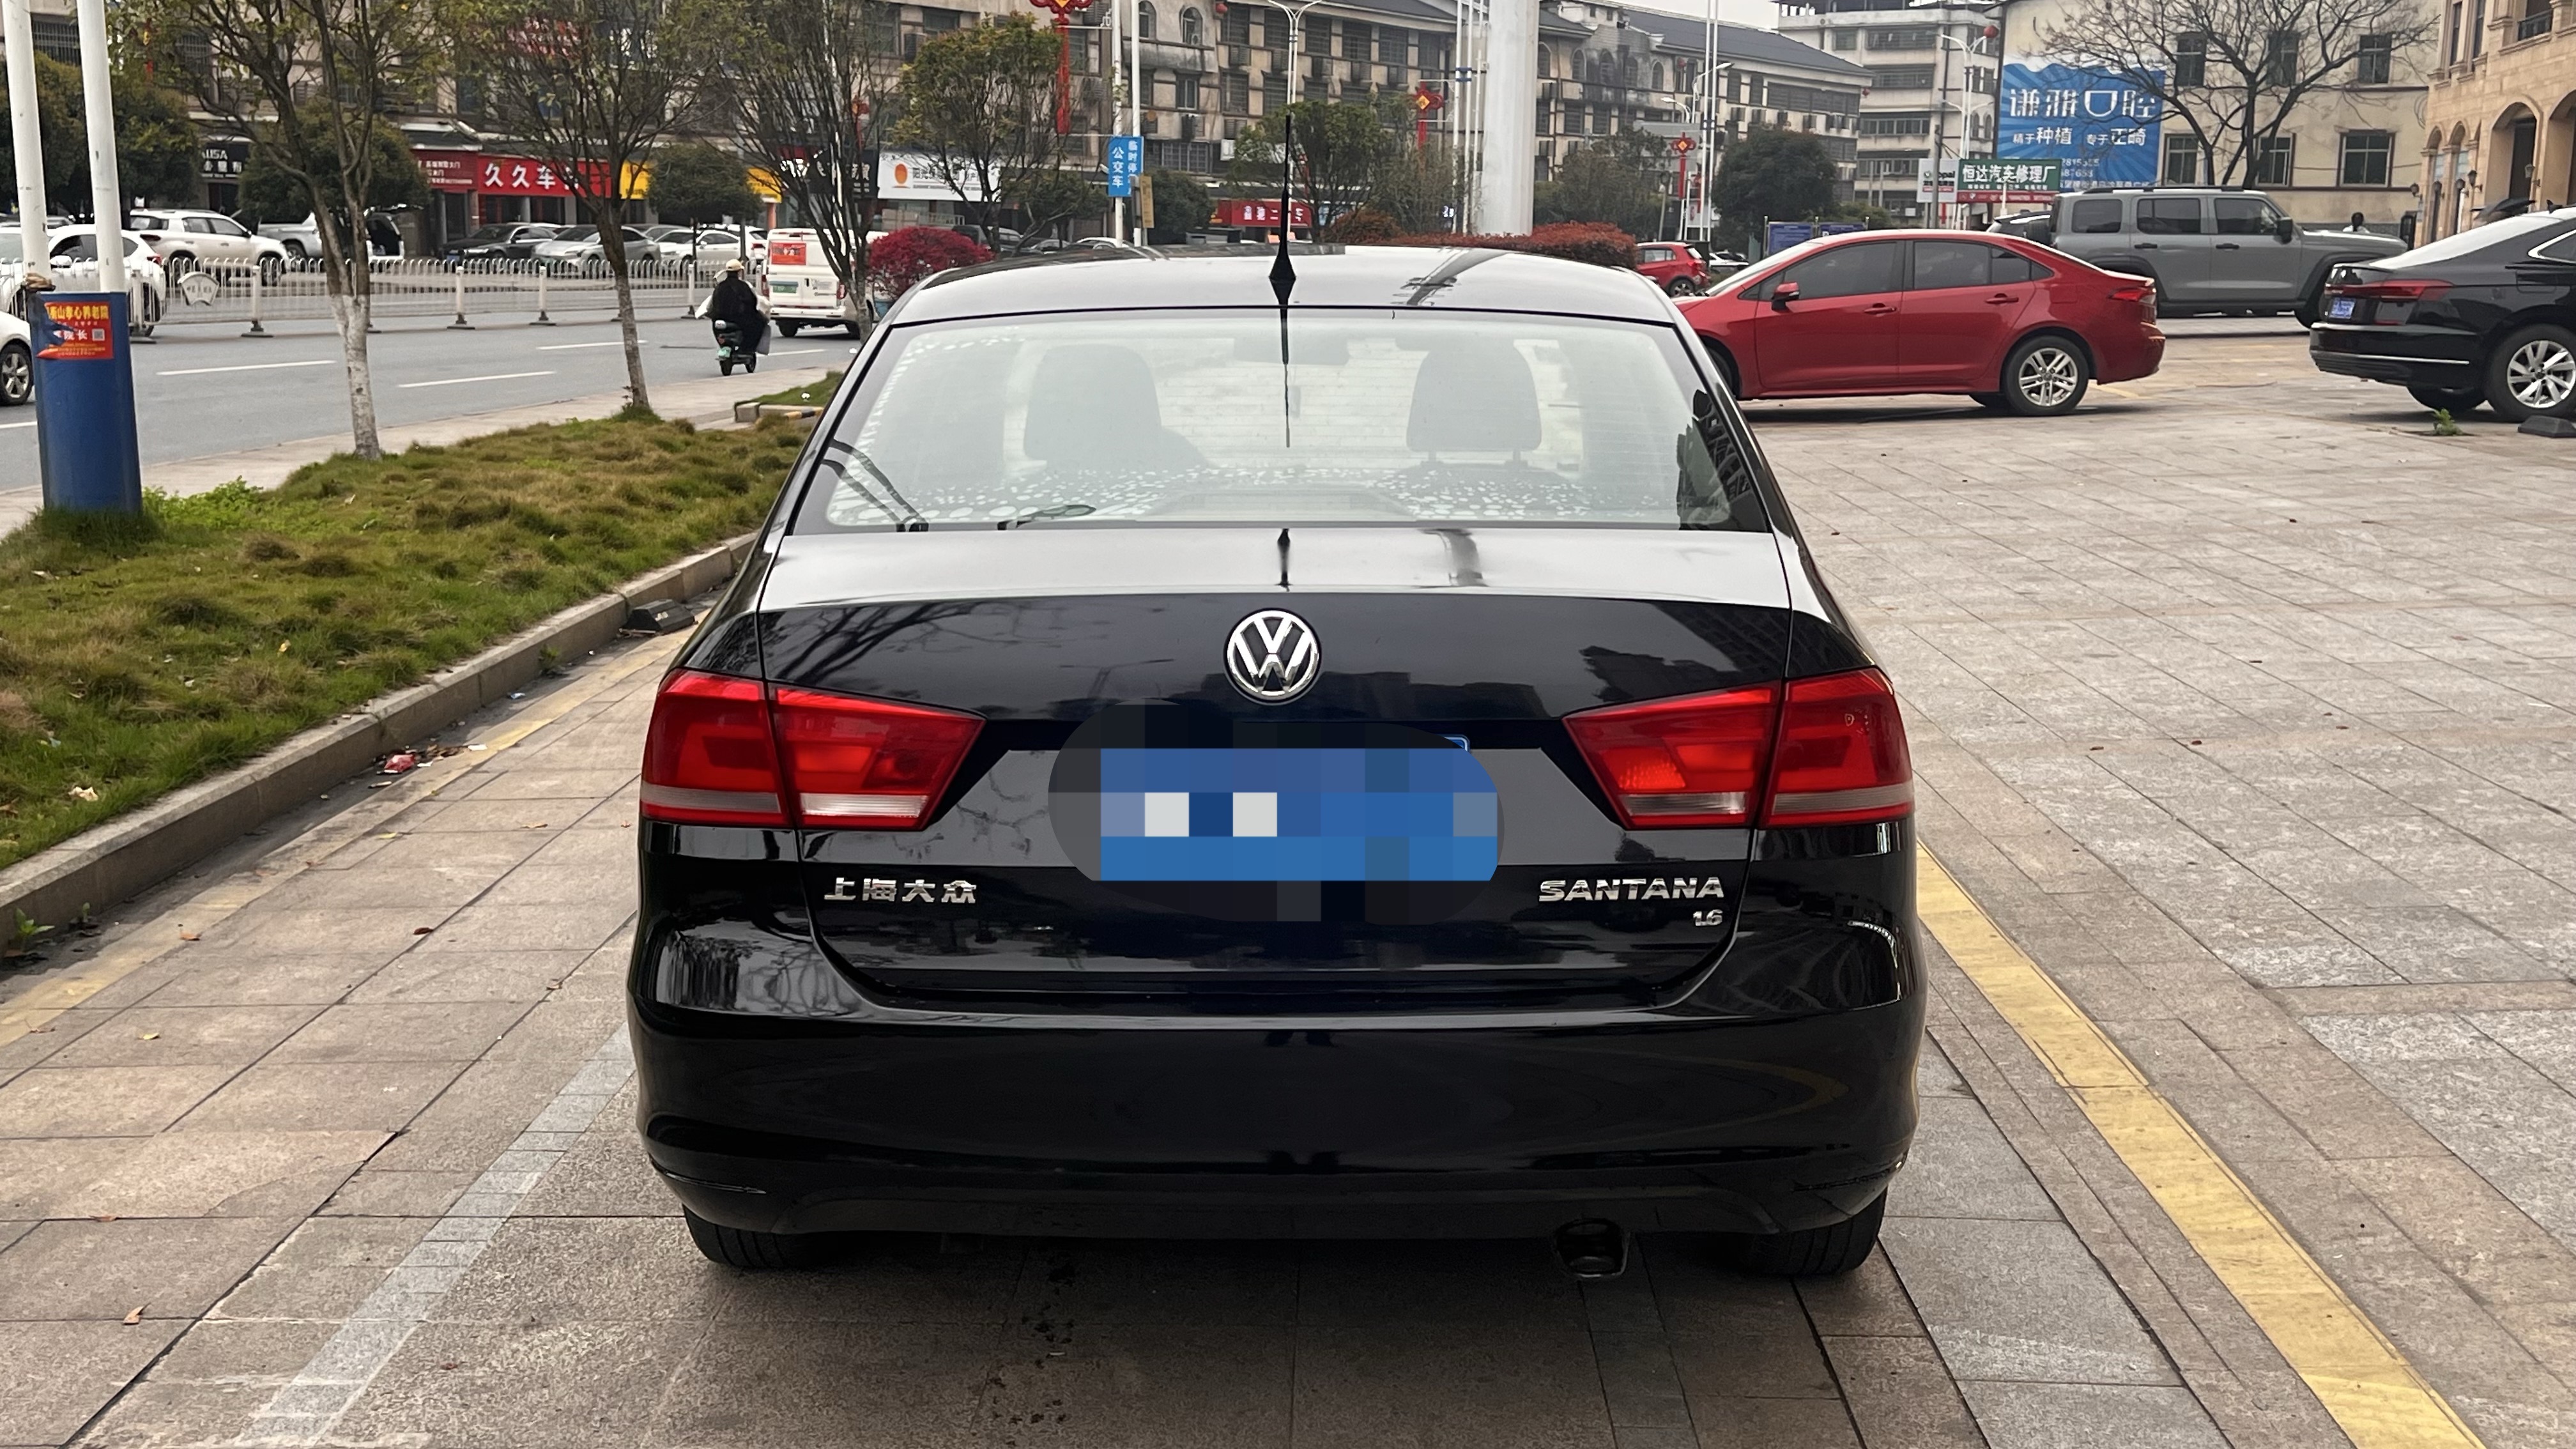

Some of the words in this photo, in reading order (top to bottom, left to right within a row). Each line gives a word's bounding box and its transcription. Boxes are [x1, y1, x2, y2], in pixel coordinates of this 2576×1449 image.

[2010, 89, 2156, 118] 谦雅口腔
[1112, 146, 1124, 188] 公交车
[1963, 164, 2057, 183] 恒达汽车修理厂
[824, 877, 977, 903] 上海大众
[1539, 877, 1724, 902] SANTANA
